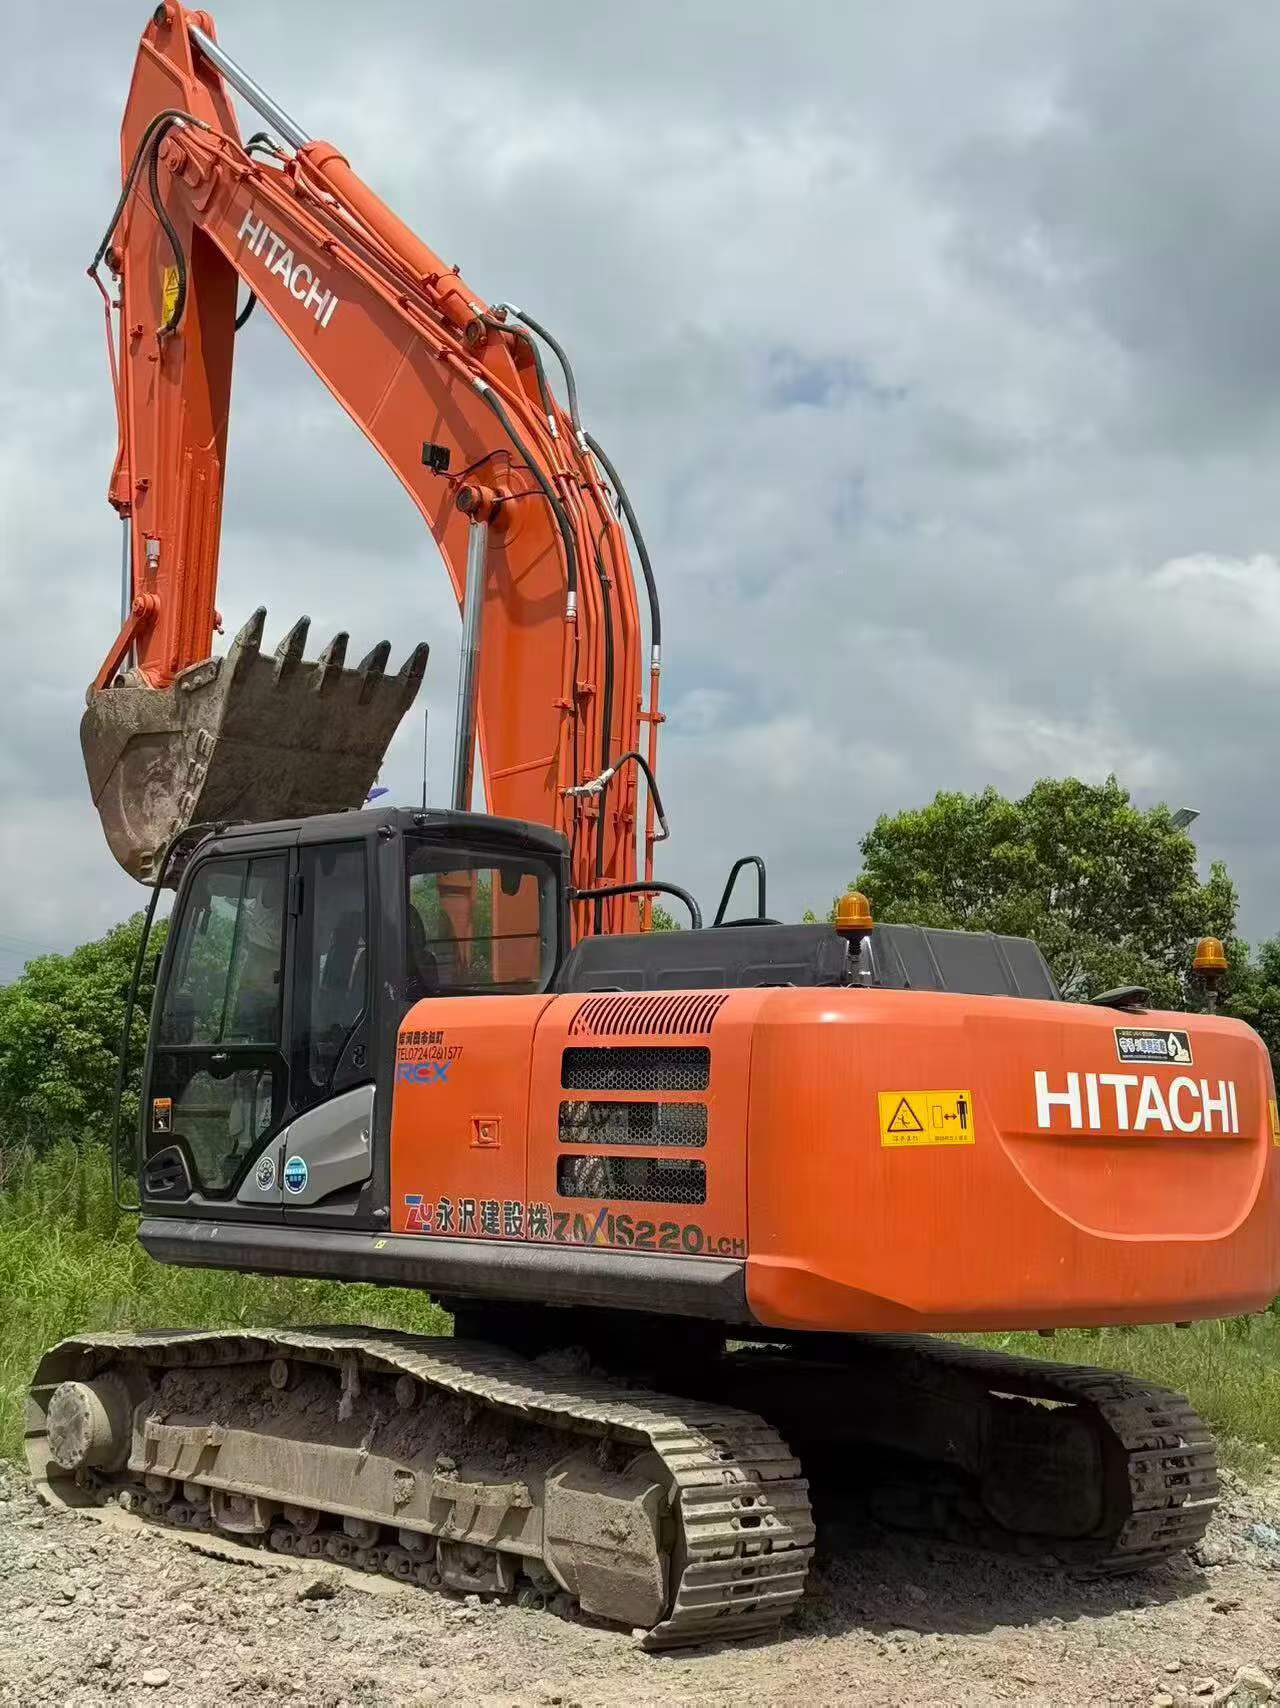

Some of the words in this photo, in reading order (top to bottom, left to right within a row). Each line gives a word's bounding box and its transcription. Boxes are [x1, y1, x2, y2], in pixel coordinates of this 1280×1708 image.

[237, 208, 339, 329] HITACHI
[1034, 1070, 1240, 1134] HITACHI
[707, 1235, 746, 1254] LCH
